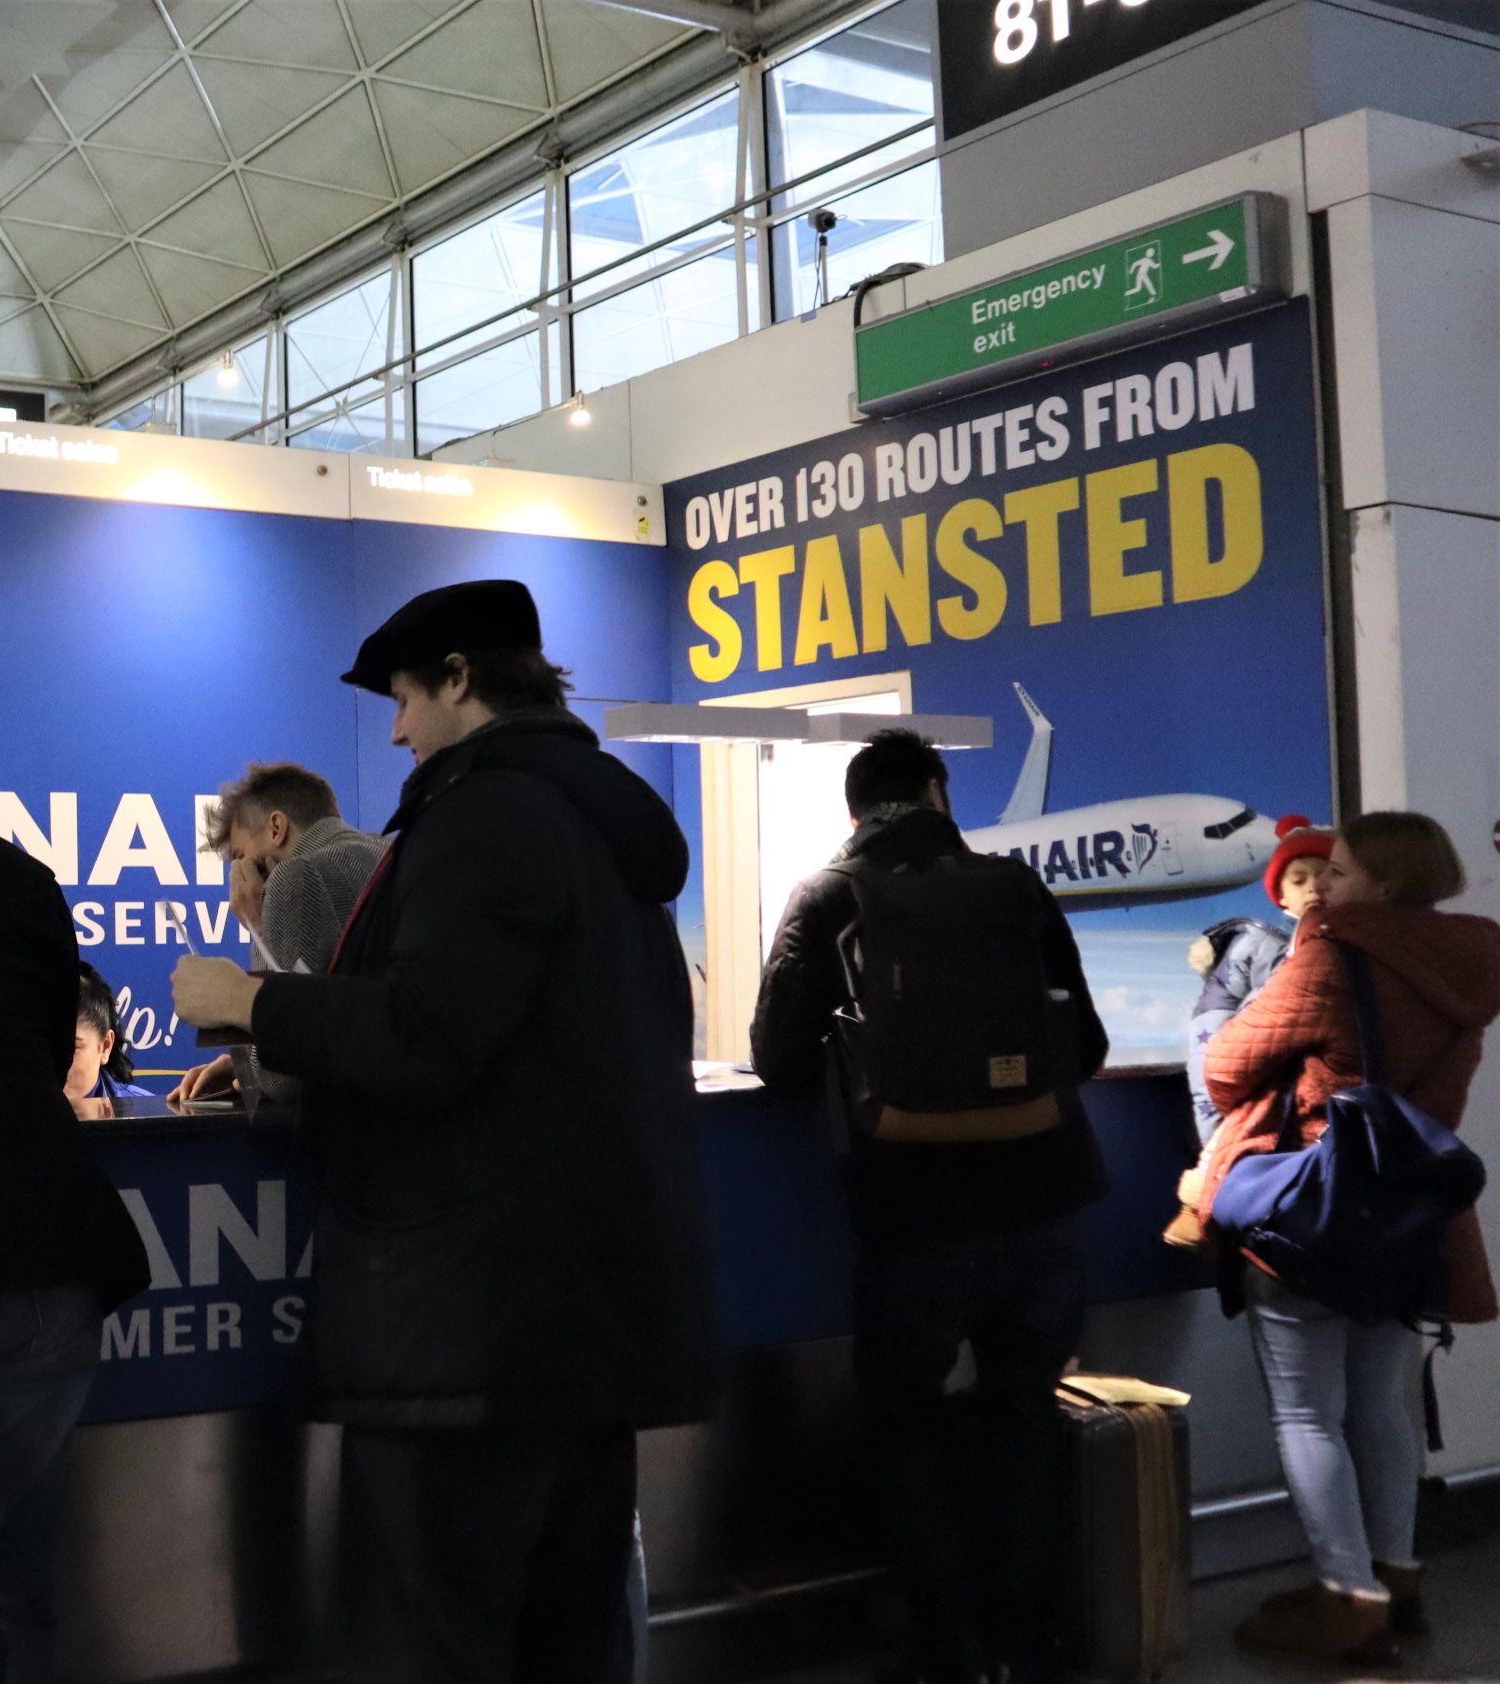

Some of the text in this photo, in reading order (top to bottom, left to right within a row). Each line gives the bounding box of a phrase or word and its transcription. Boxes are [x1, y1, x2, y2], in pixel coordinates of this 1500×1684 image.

[994, 0, 1148, 64] 81-
[971, 264, 1106, 324] Emergency
[973, 321, 1016, 353] exit
[685, 343, 1256, 549] OVER 130 ROUTES FROM
[366, 466, 422, 491] Ticket
[687, 442, 1265, 684] STANSTED
